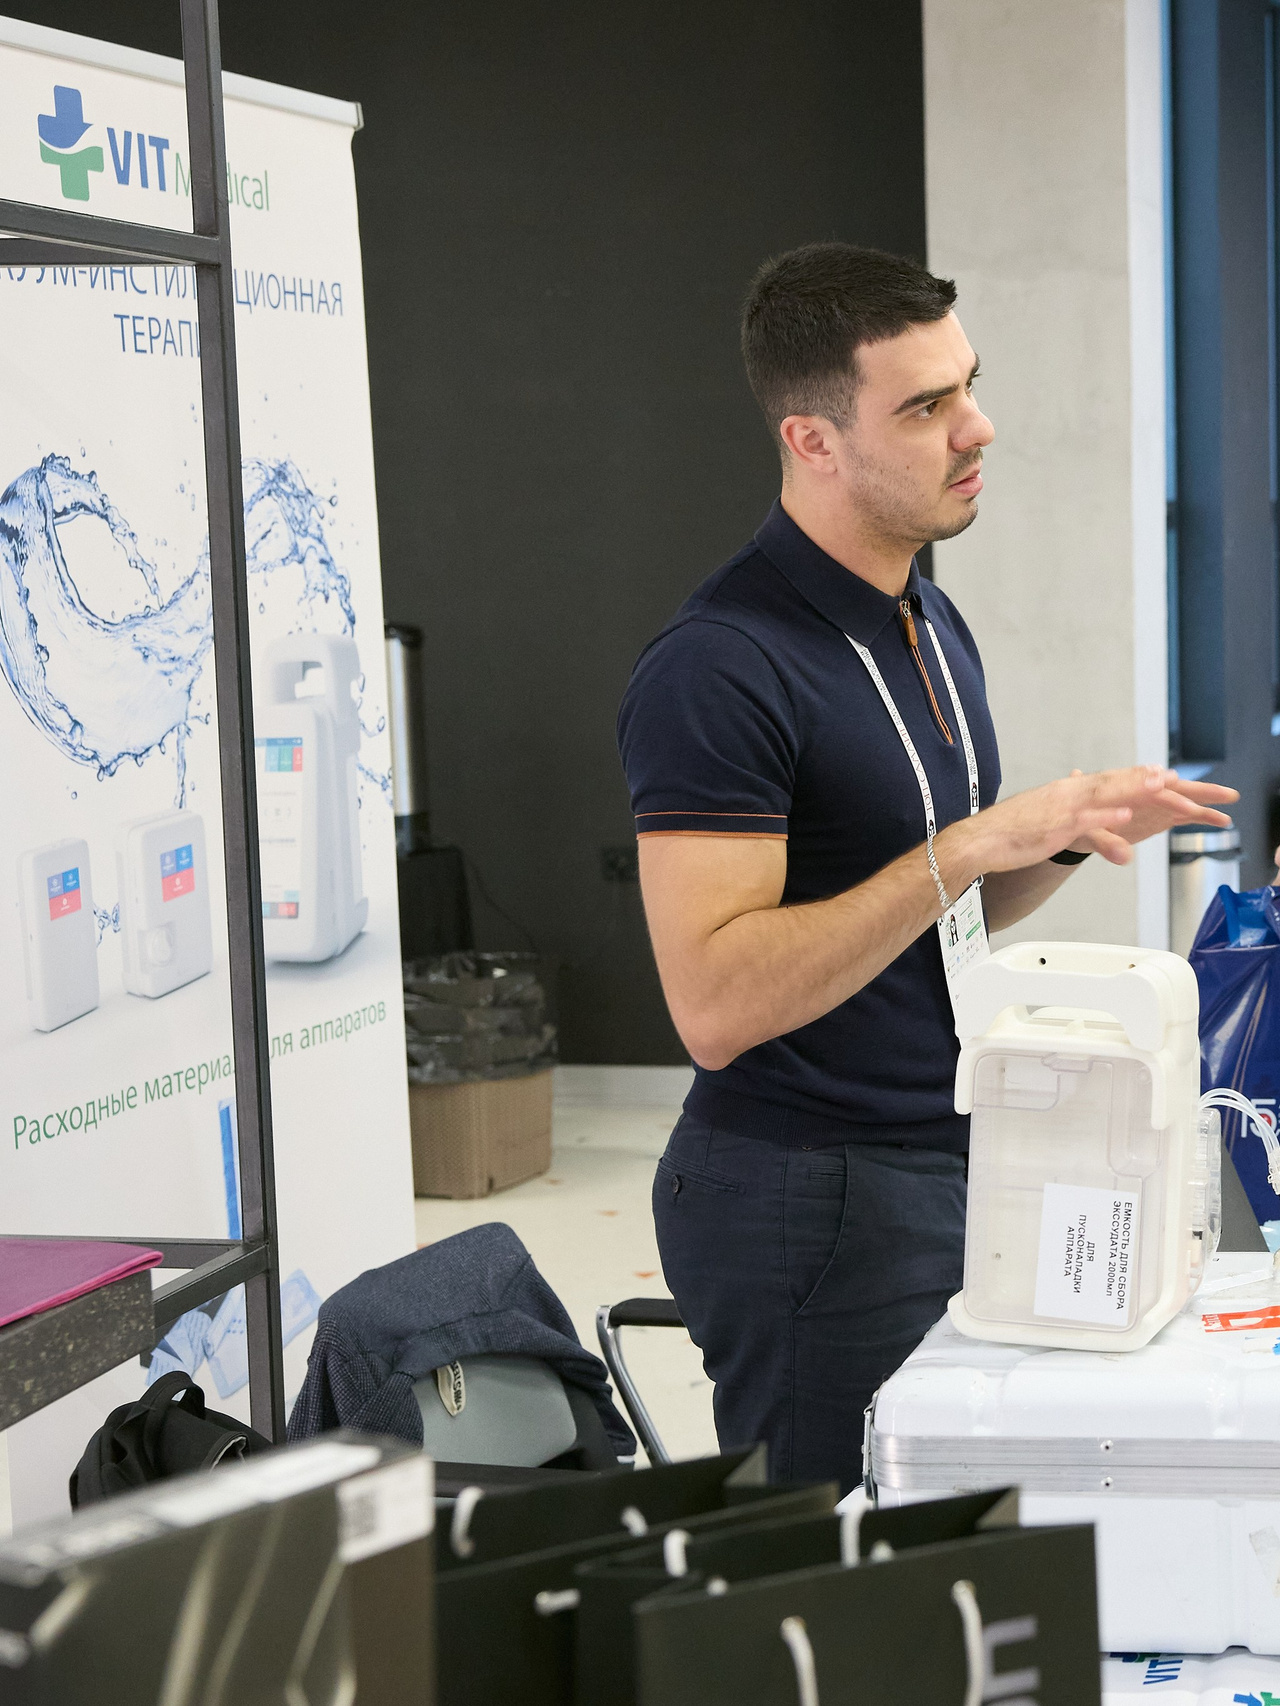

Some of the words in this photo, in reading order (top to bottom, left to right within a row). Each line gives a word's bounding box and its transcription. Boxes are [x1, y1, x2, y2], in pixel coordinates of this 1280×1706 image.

[106, 126, 170, 192] VIT
[12, 1086, 138, 1150] Расходные
[144, 1054, 235, 1106] материа
[270, 1031, 293, 1059] ля
[299, 1001, 386, 1050] аппаратов
[1108, 1200, 1122, 1259] ЭКССУДАТА
[1121, 1201, 1134, 1251] ЕМКОСТЬ
[1063, 1225, 1075, 1278] АППАРАТА
[1073, 1214, 1087, 1294] ПУСКОНАЛАДКИ
[1086, 1240, 1096, 1263] ДЛЯ
[1118, 1251, 1130, 1274] ДЛЯ
[1105, 1261, 1117, 1297] 2000мл
[1115, 1275, 1127, 1311] СБОРА
[1143, 1659, 1183, 1685] VIT
